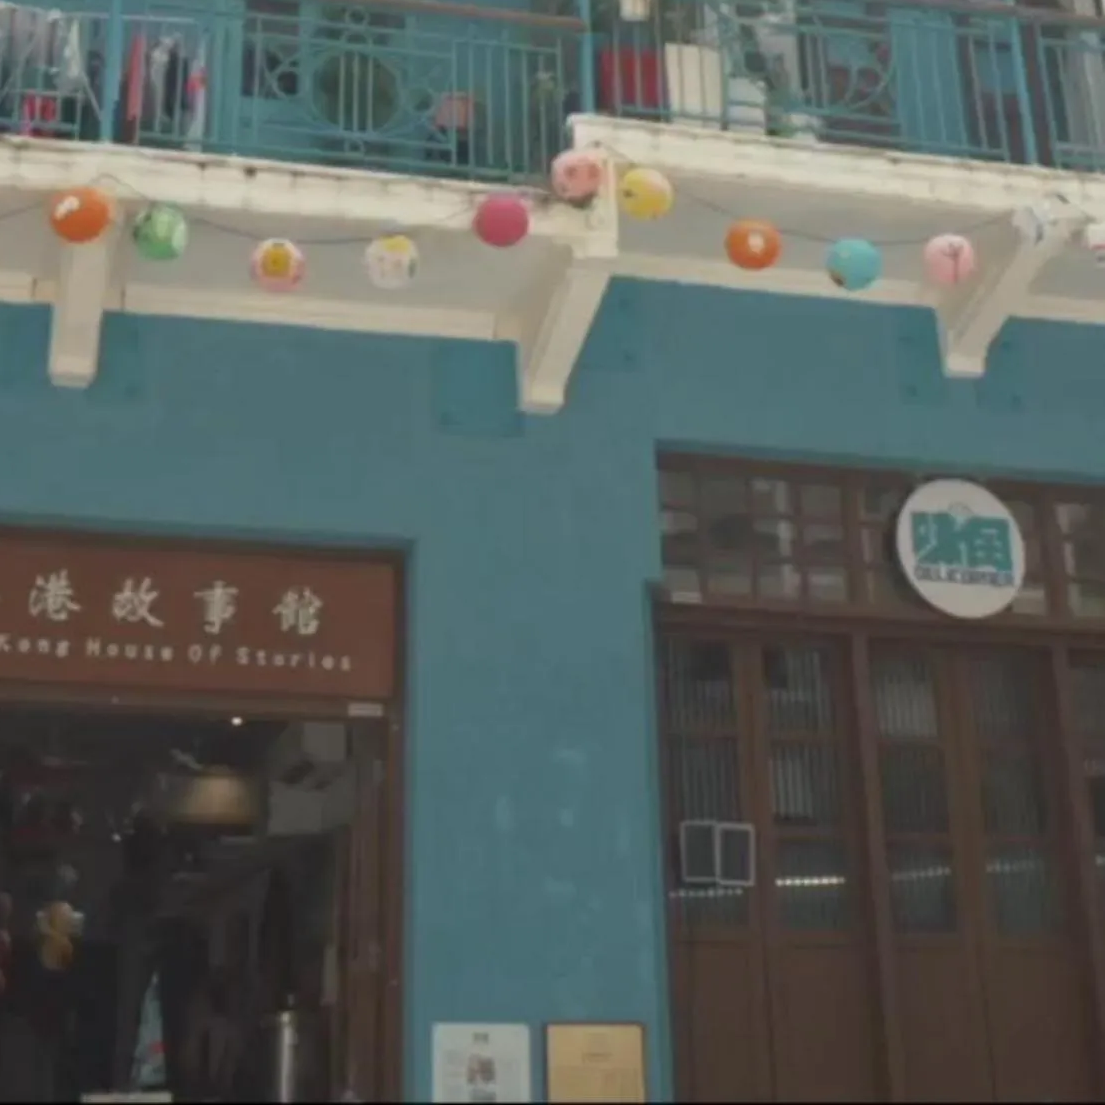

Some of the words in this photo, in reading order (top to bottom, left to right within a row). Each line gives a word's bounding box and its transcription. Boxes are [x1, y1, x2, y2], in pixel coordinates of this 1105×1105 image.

[86, 637, 174, 661] House
[188, 644, 222, 665] Of
[236, 647, 351, 672] Stories
